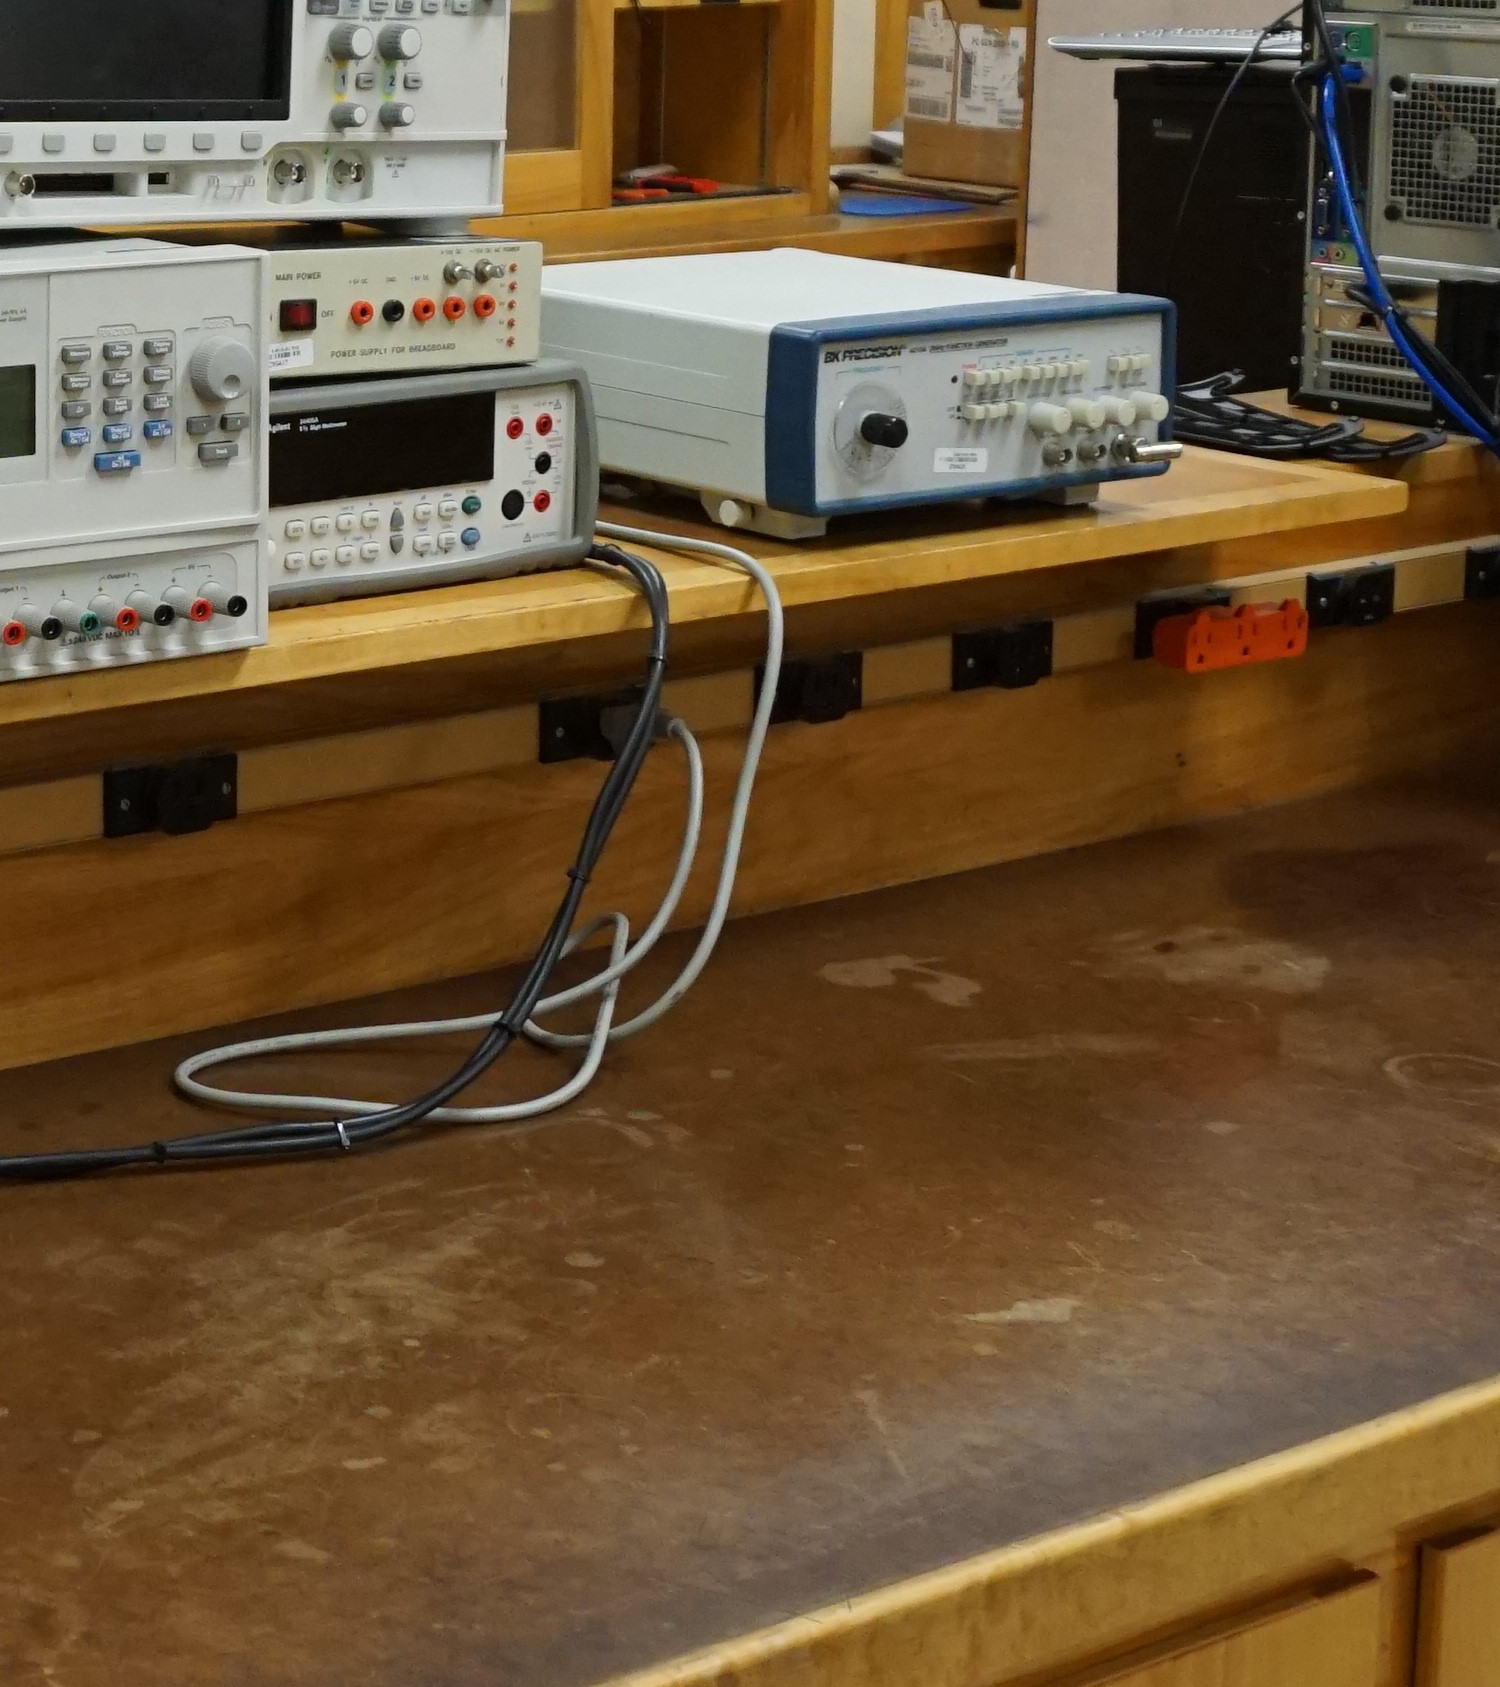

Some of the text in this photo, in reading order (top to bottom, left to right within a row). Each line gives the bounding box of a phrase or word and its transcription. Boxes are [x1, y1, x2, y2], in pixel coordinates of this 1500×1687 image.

[389, 76, 395, 86] 2
[296, 272, 321, 280] POWER
[321, 310, 335, 318] OFF
[70, 350, 90, 358] Memory
[330, 343, 456, 358] POWER SUPPLY FOR BREADBOARD
[824, 350, 840, 362] BK
[841, 345, 902, 362] PRECISION
[105, 630, 124, 639] MAX
